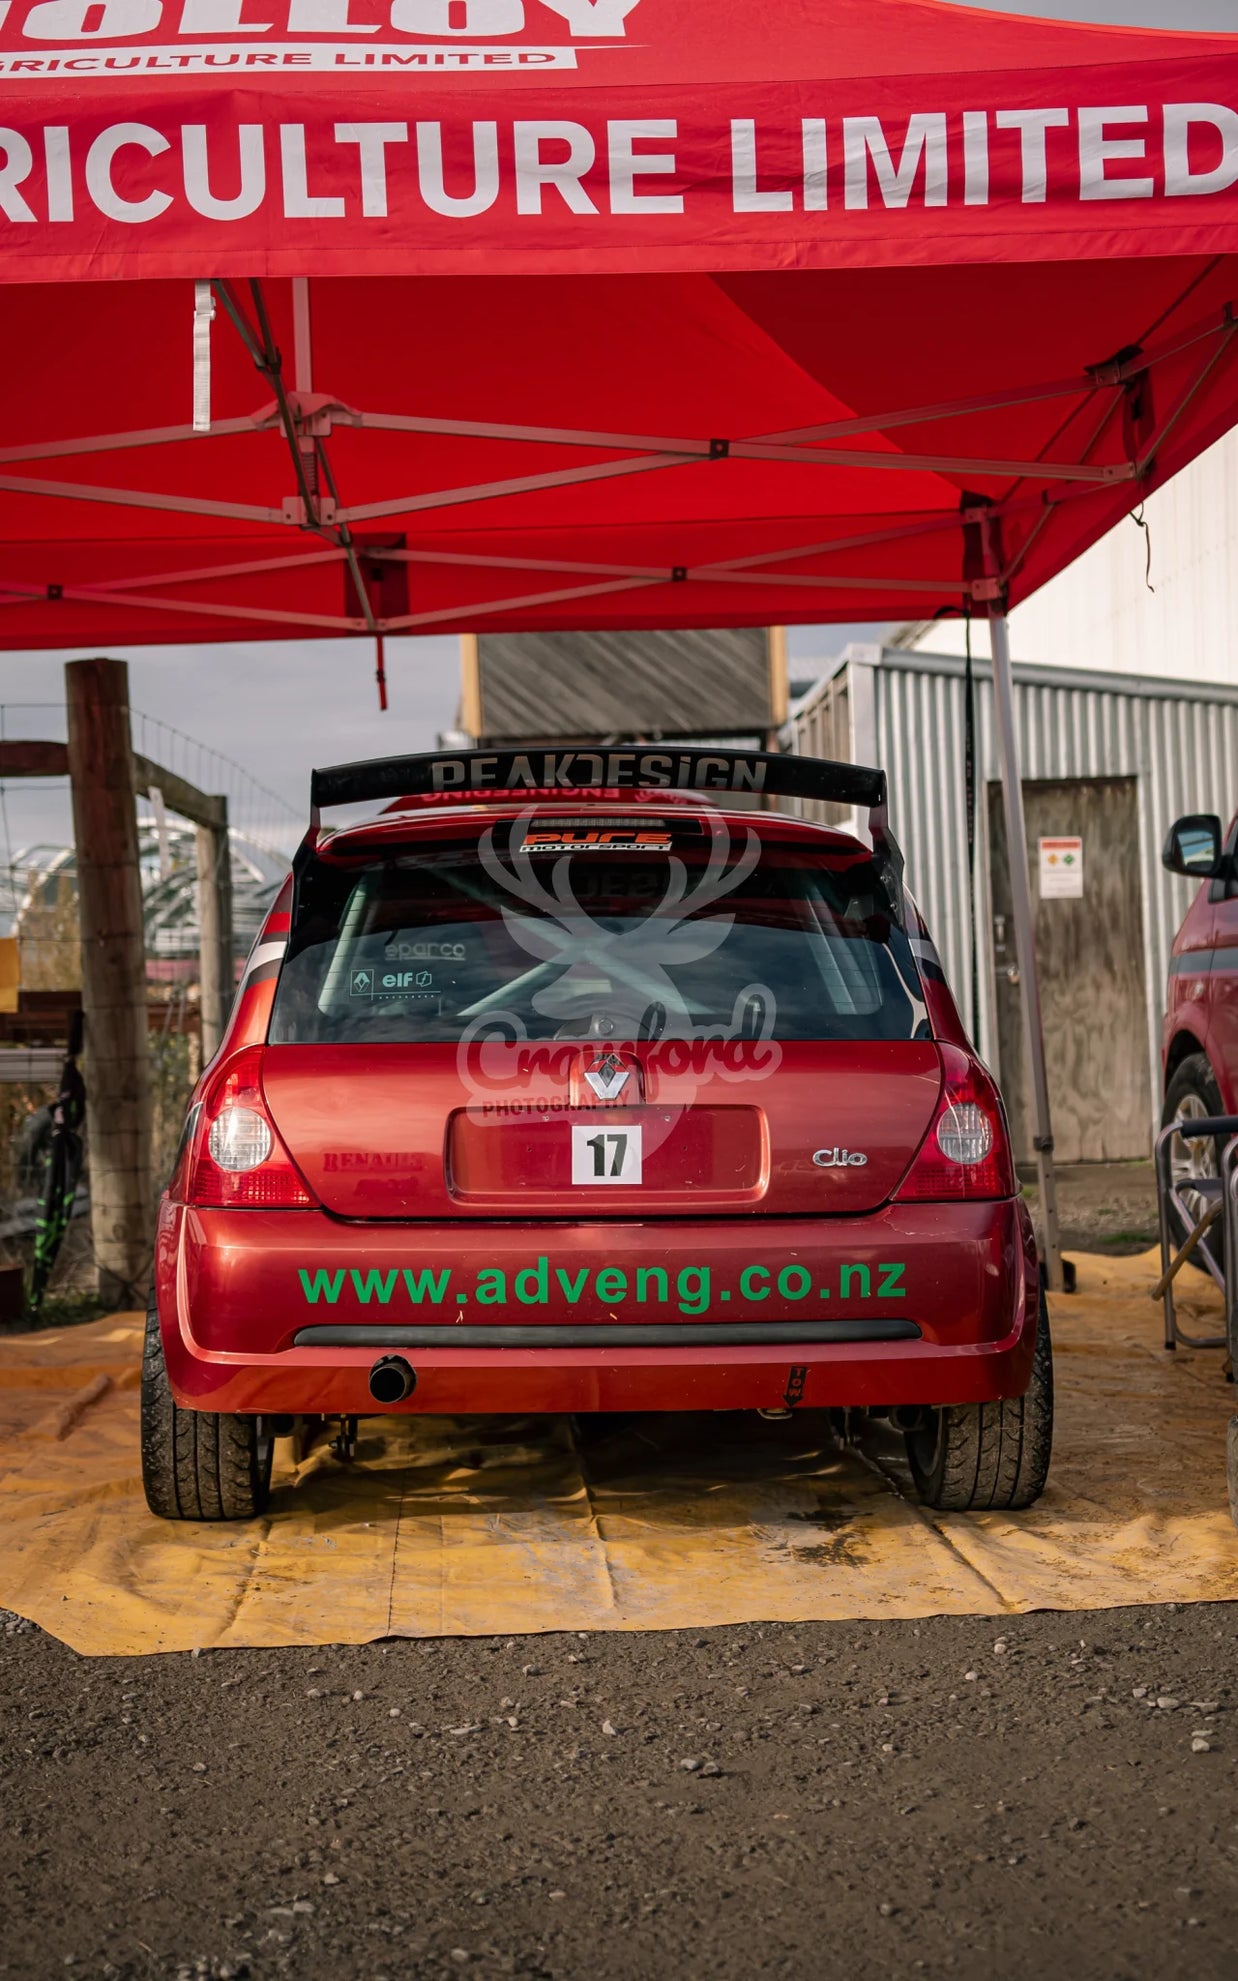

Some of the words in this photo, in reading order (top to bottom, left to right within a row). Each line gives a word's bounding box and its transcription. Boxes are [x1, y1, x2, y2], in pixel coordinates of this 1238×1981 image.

[0, 0, 641, 40] OLLOY
[334, 52, 556, 65] LIMITED
[730, 102, 1238, 213] LIMITED
[382, 972, 413, 987] elf
[587, 1134, 628, 1177] 17
[812, 1147, 868, 1167] Clio
[298, 1256, 907, 1314] www.adveng.co.nz
